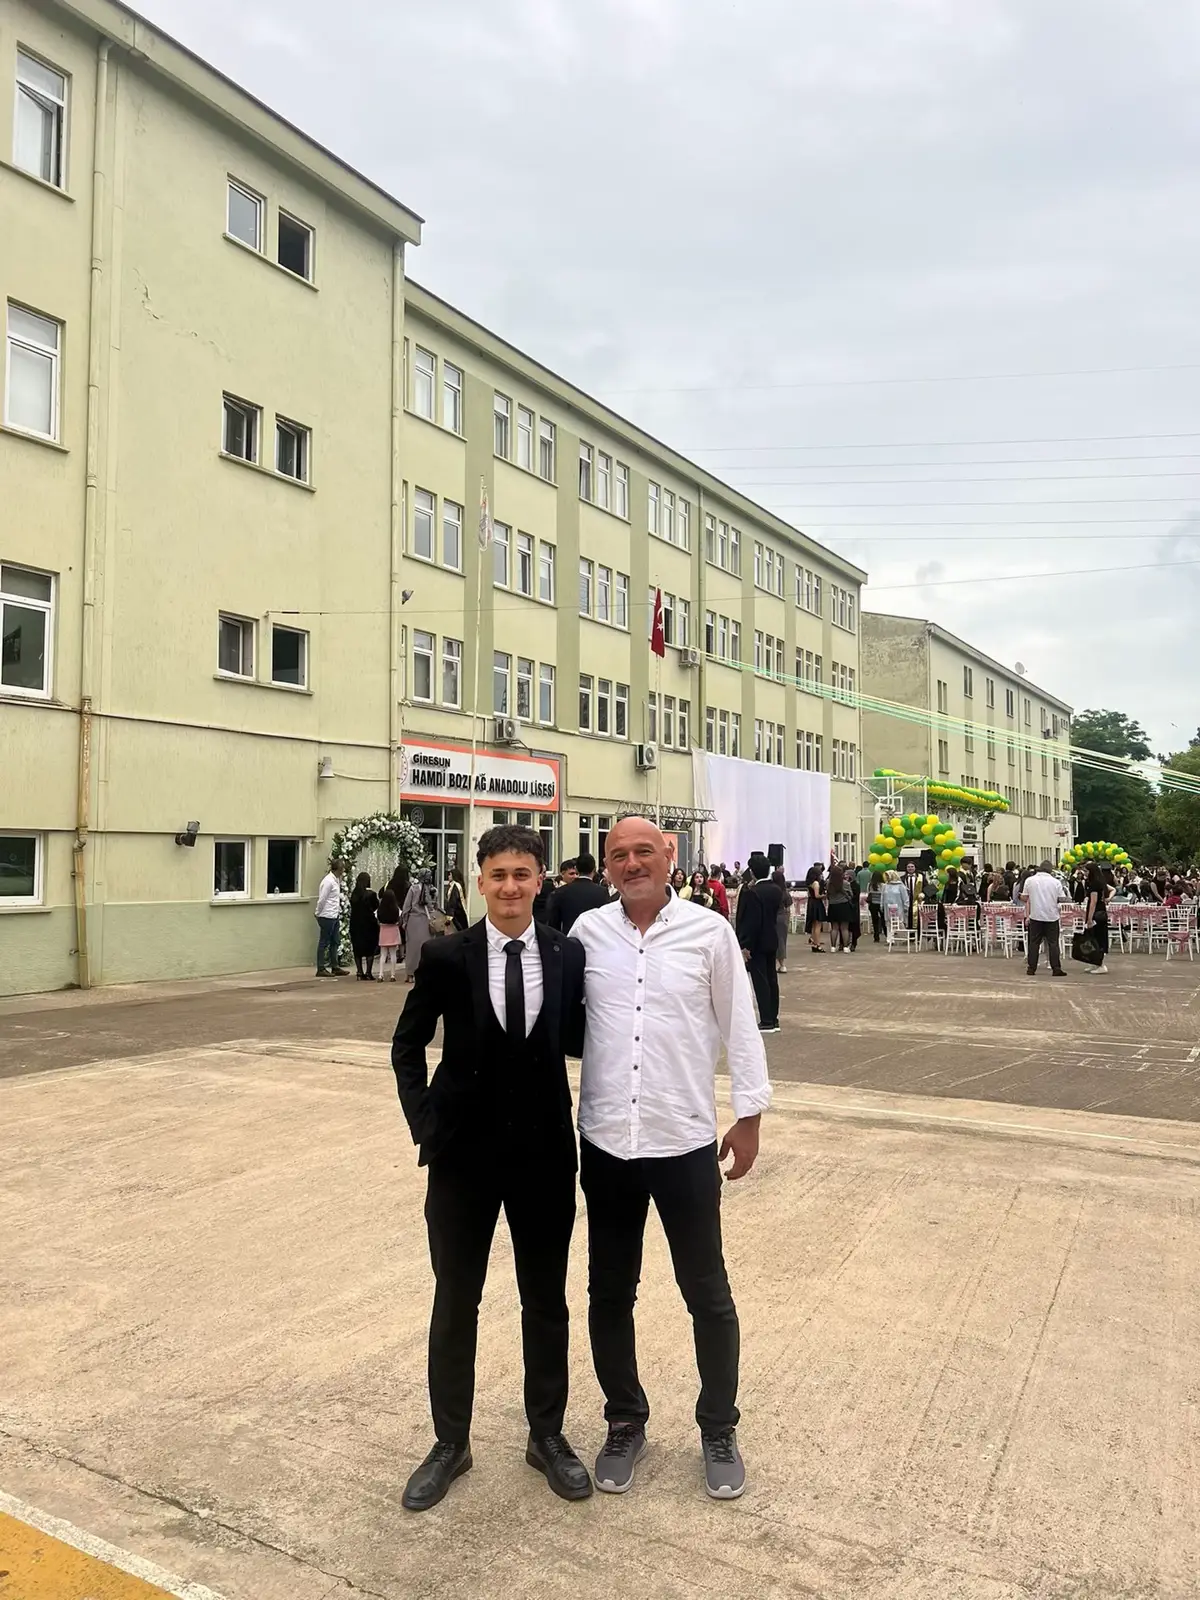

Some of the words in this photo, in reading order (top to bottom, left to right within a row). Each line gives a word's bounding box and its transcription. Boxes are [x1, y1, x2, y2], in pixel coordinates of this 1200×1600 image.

[413, 752, 450, 767] GİRESUN
[412, 769, 446, 787] HAMDİ
[489, 777, 528, 795] ANADOLU
[530, 780, 555, 797] LİSESİ
